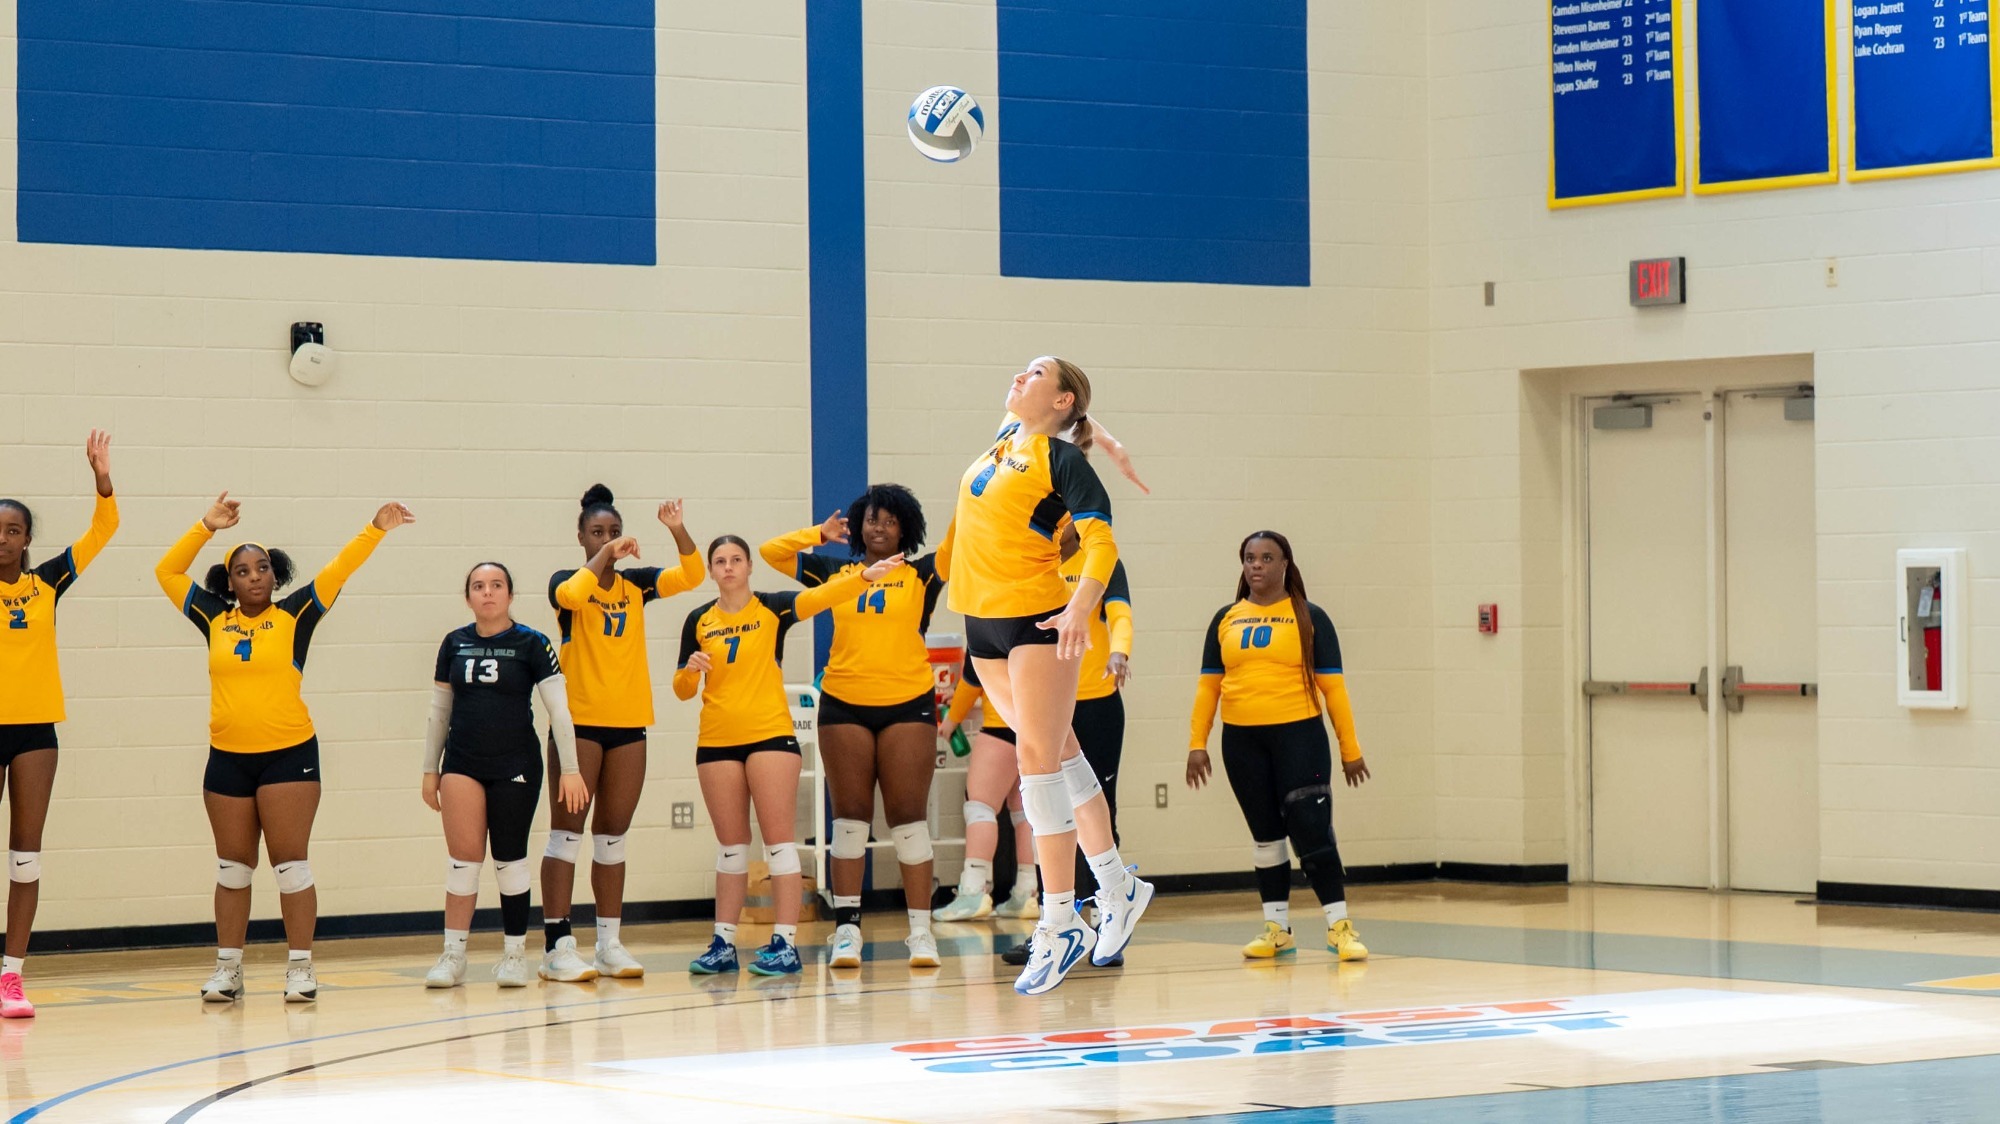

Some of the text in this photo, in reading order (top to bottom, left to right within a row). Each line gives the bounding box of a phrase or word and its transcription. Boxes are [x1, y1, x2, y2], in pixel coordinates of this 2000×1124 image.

[1552, 4, 1580, 17] Camden
[1854, 5, 1878, 19] Logan
[1879, 2, 1905, 15] Jarrett
[1553, 24, 1587, 36] Stevenson
[1587, 20, 1610, 32] Barnes
[1854, 24, 1873, 39] Ryan
[1874, 22, 1903, 38] Regner
[1967, 11, 1987, 23] Team
[1553, 42, 1580, 55] Camden
[1854, 44, 1872, 57] Luke
[1872, 42, 1905, 55] Cochran
[1967, 32, 1987, 44] Team
[1553, 61, 1574, 74] Dillon
[1553, 82, 1575, 95] Logan
[1575, 77, 1599, 91] Shaffer
[1637, 260, 1671, 299] EXIT
[970, 463, 997, 497] 8
[856, 588, 886, 614] 14
[9, 607, 28, 629] 2
[602, 610, 627, 637] 17
[1240, 624, 1273, 650] 10
[233, 638, 253, 662] 4
[724, 635, 741, 665] 7
[464, 658, 499, 683] 13
[792, 720, 812, 730] RADE
[890, 999, 1573, 1054] COAST
[923, 1015, 1630, 1074] COAST
